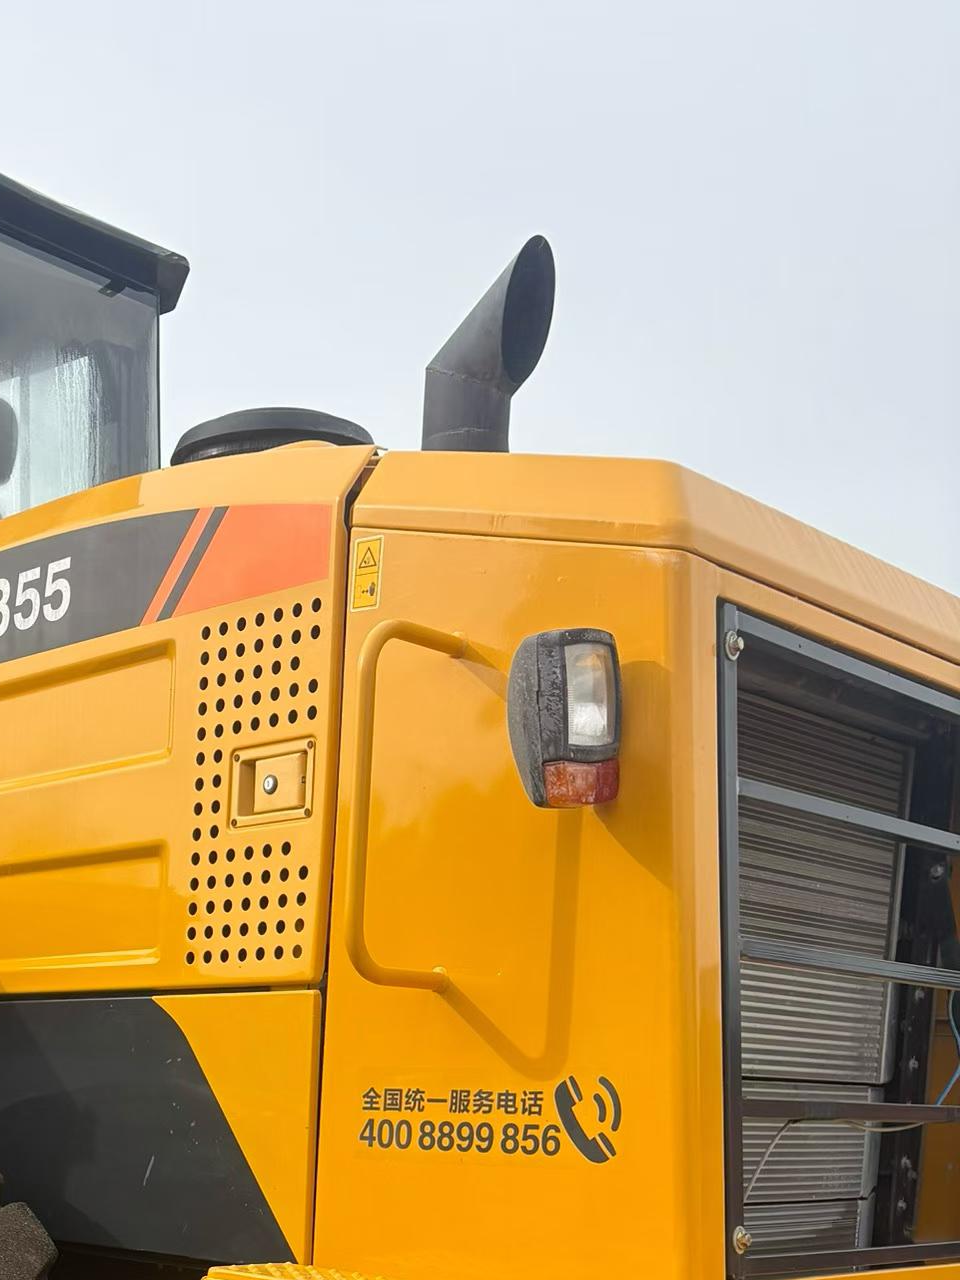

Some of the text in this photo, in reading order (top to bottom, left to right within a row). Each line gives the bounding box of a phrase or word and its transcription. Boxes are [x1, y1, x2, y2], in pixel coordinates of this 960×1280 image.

[361, 1087, 544, 1117] 全国统一服务电话
[359, 1118, 561, 1156] 400 8899 856
